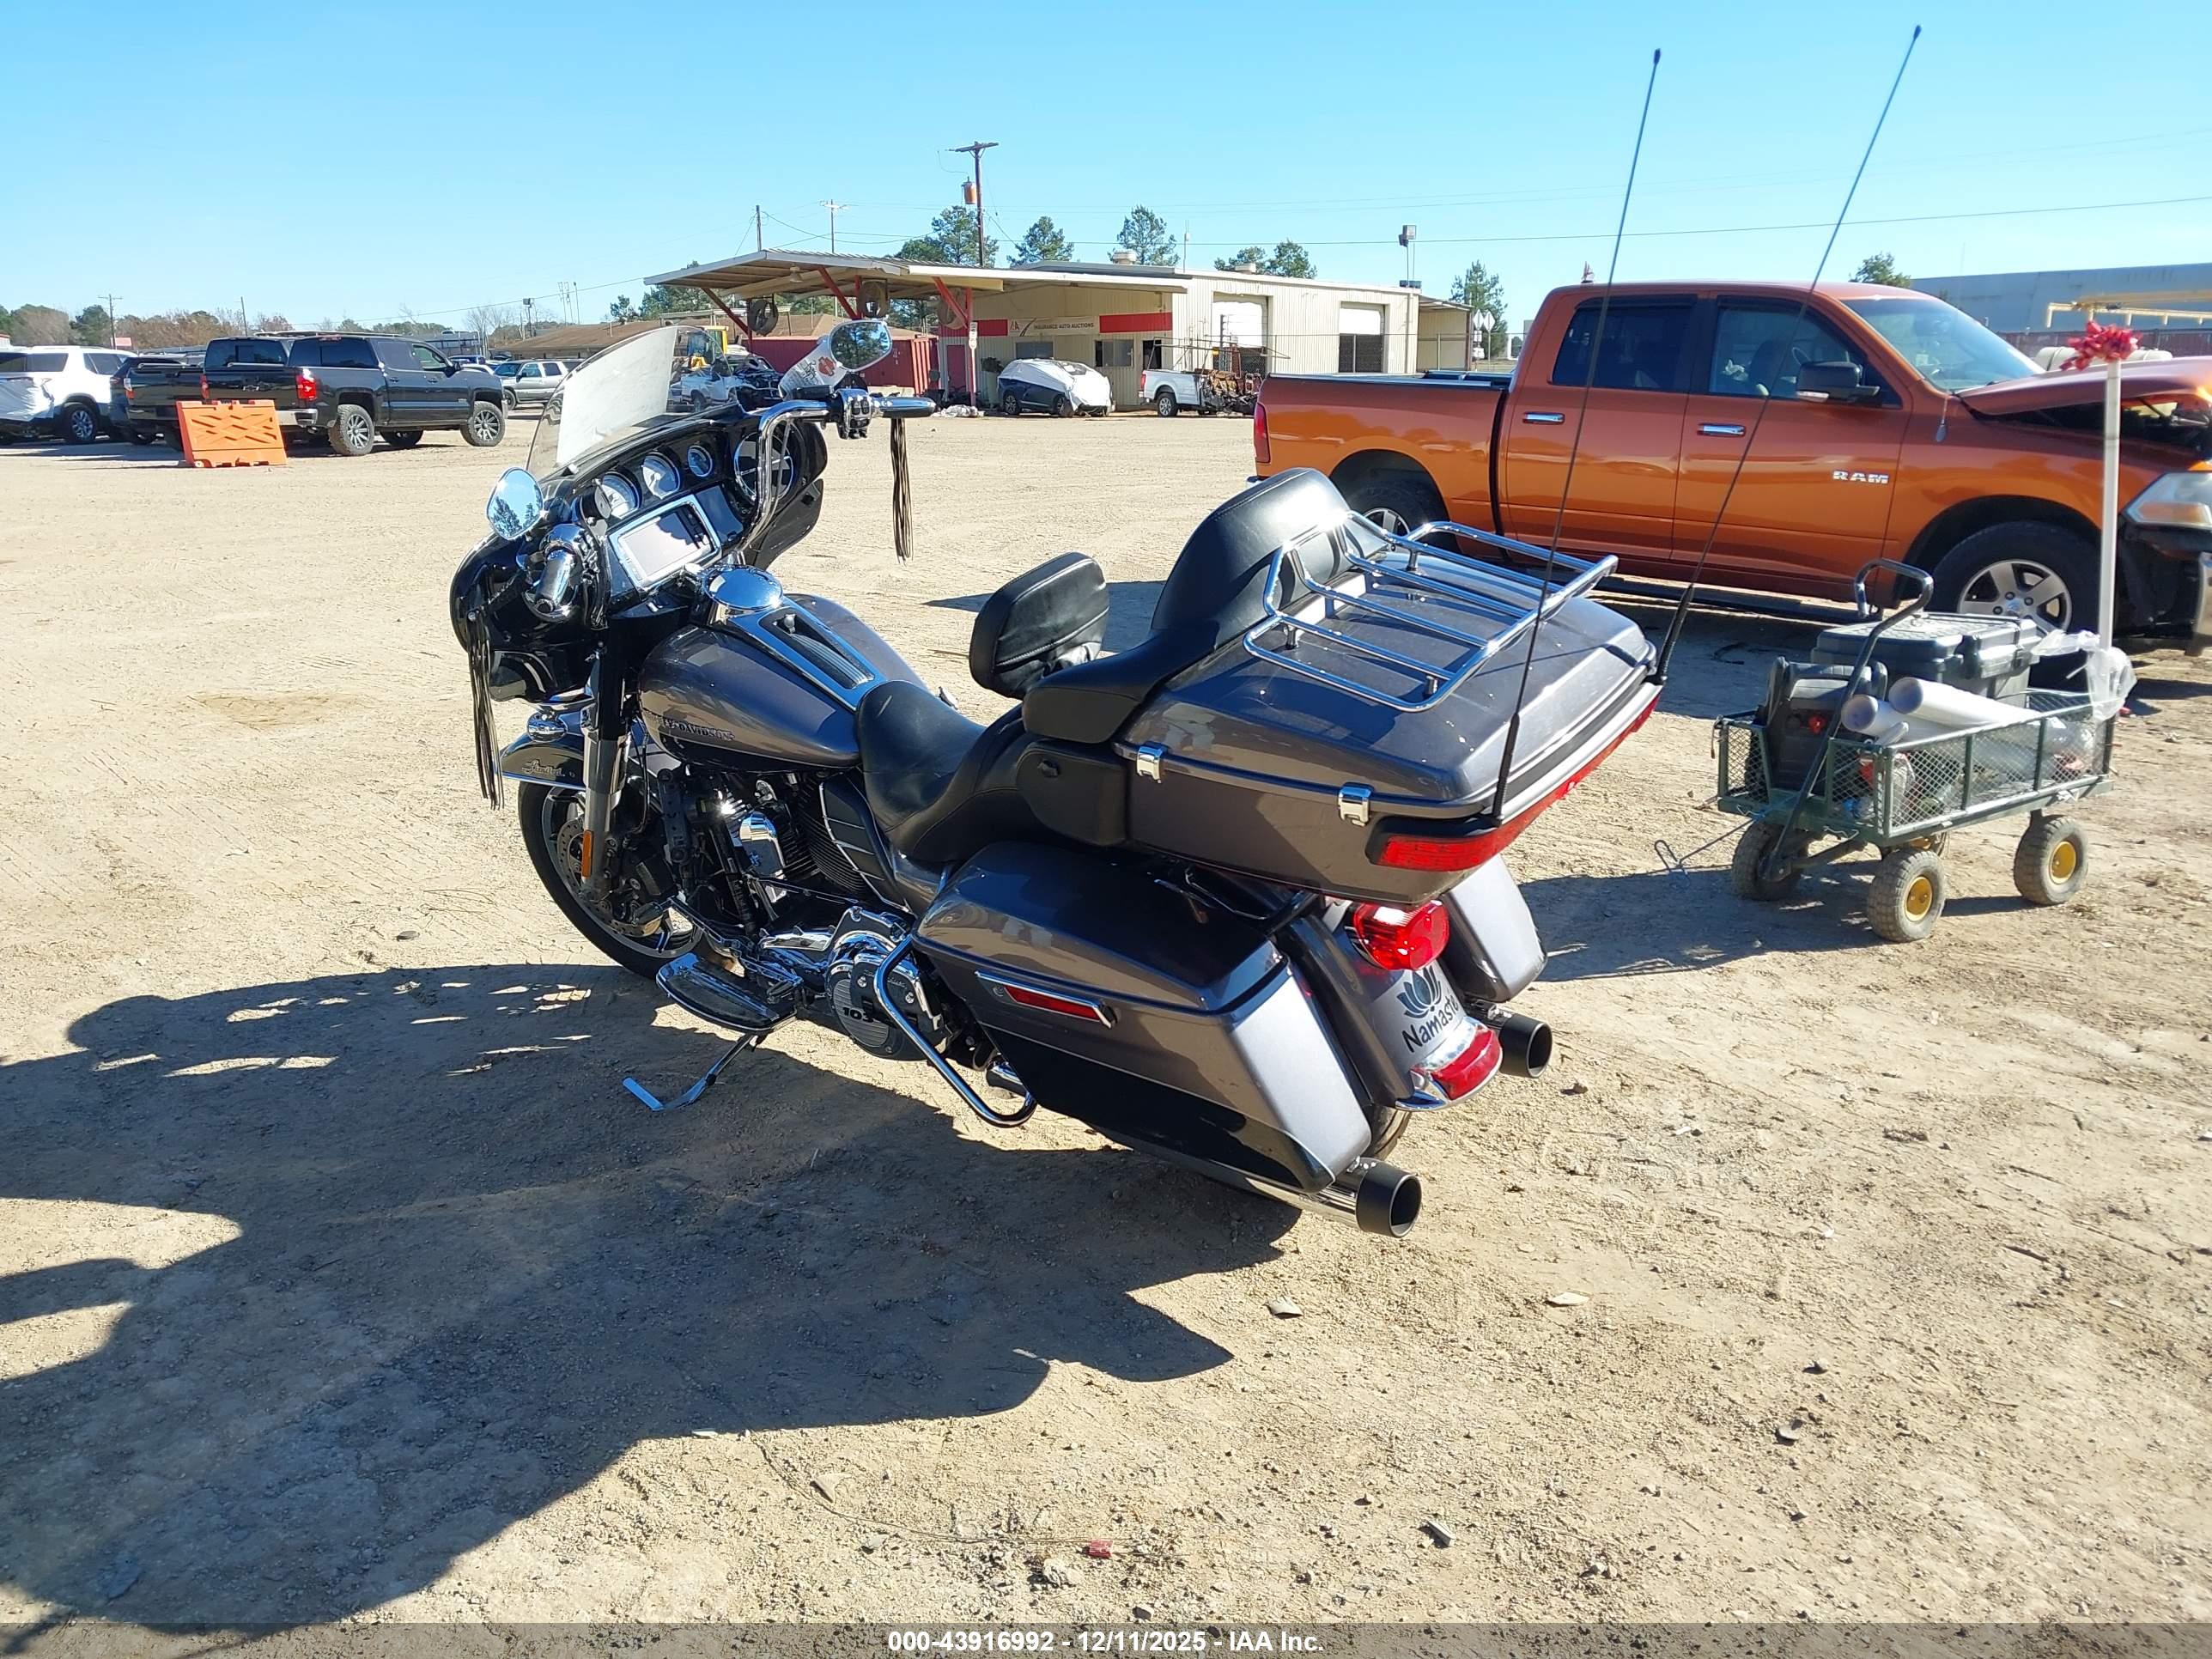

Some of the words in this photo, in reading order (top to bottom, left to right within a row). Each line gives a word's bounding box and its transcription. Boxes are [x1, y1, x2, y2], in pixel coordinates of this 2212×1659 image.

[1833, 471, 1889, 484] RAM
[843, 1007, 873, 1023] 103
[1402, 994, 1459, 1053] Namaste
